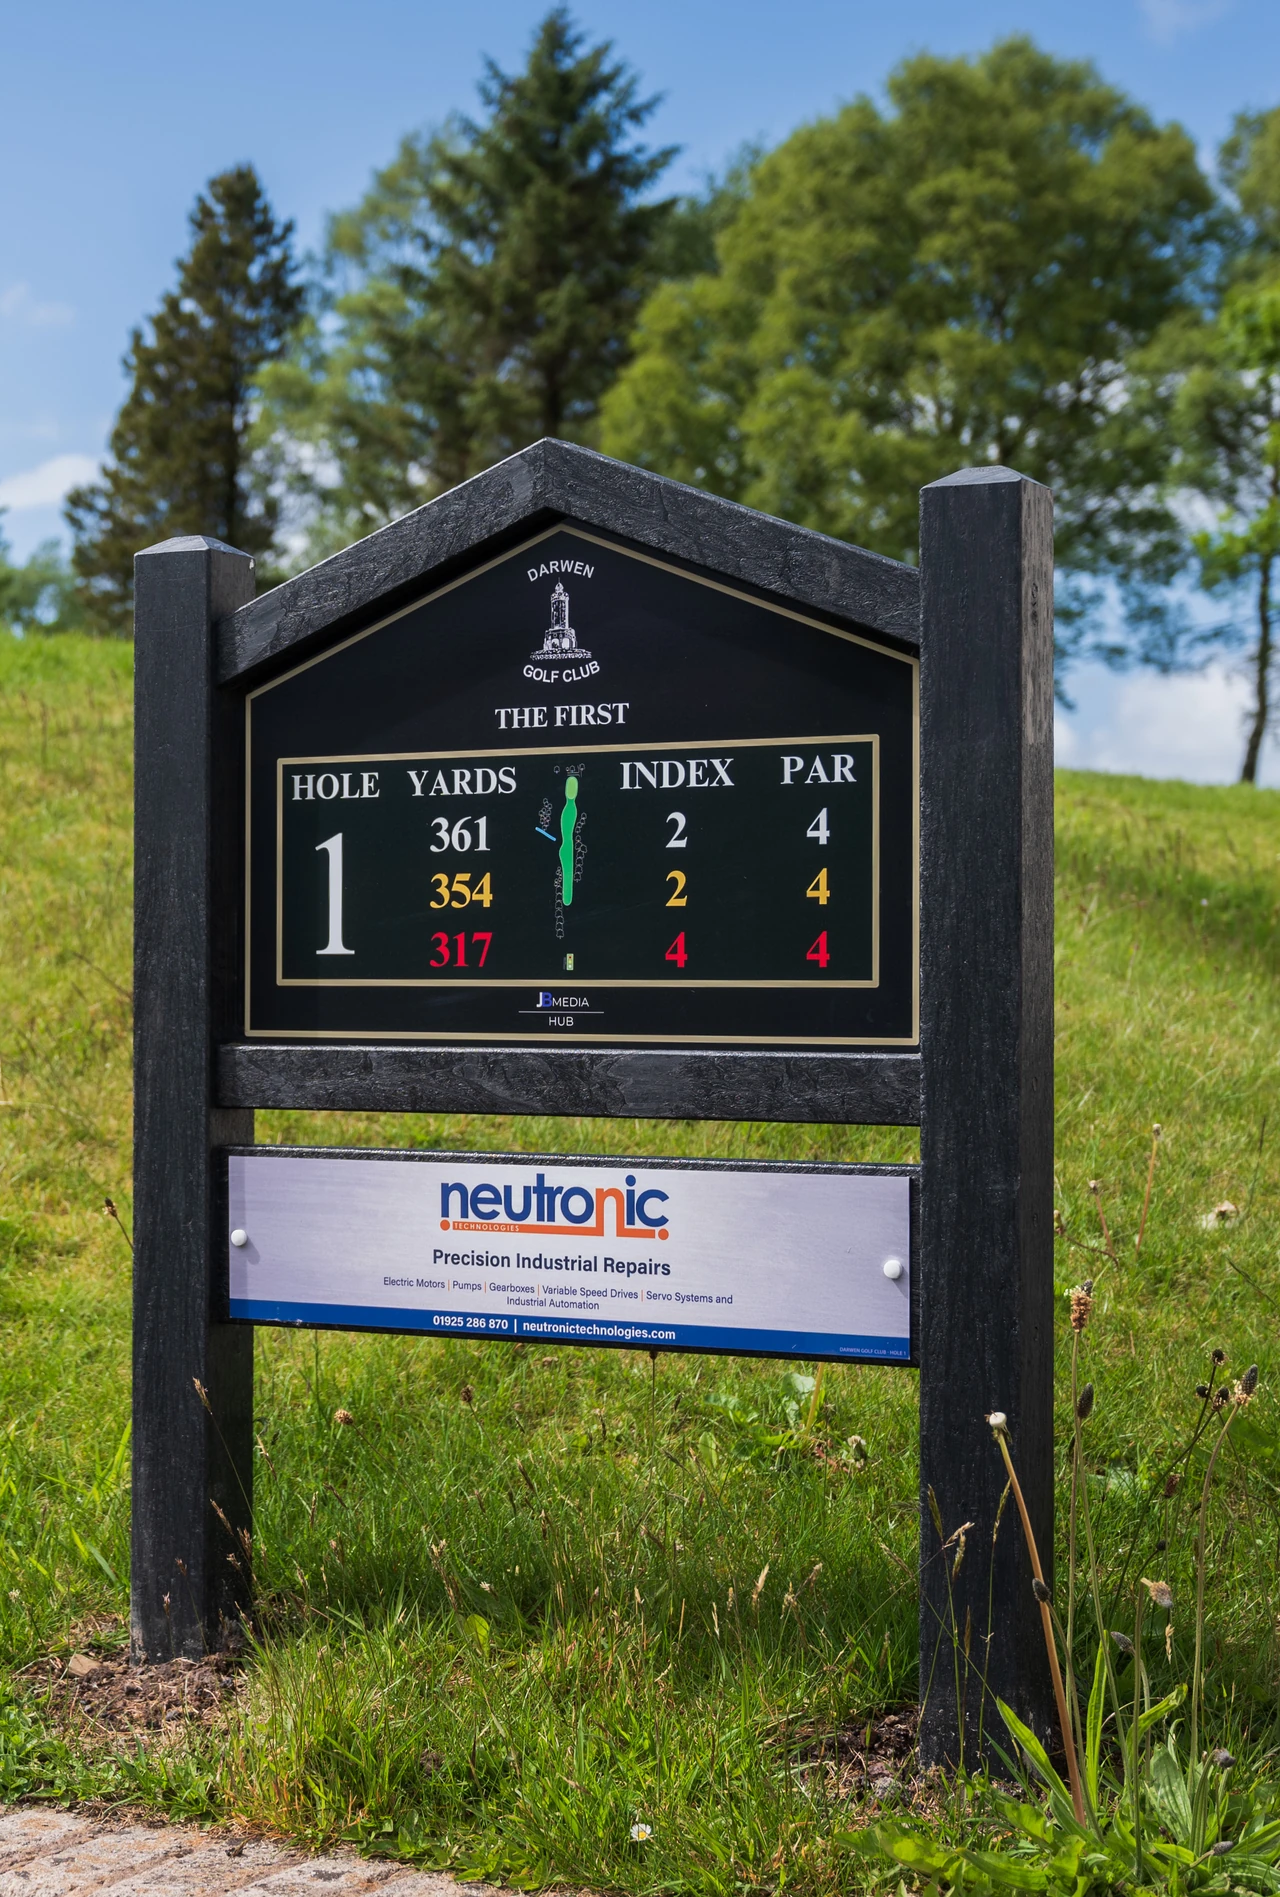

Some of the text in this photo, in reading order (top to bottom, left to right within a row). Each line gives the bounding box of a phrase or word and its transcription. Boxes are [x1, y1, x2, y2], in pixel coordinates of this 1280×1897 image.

[527, 559, 595, 582] DARWEN
[523, 661, 600, 683] GOLF CLUB
[495, 703, 629, 729] THE FIRST
[292, 755, 856, 800] HOLE YARDS INDEX PAR
[430, 808, 830, 852] 361 2 4
[316, 833, 355, 954] 1
[430, 868, 830, 908] 354 2 4
[430, 931, 830, 967] 317 4 4
[548, 1016, 574, 1027] HUB
[440, 1173, 670, 1229] neutronic
[454, 1222, 520, 1232] TECHNOLOGIES
[433, 1248, 671, 1278] Precision Industrial Repairs
[383, 1276, 732, 1304] Electric Motors Pumps Gearboxes Variable Speed Drives Servo Systems and
[507, 1297, 600, 1309] Industrial Automation
[432, 1315, 676, 1340] 01925 286 870 neutronictechnologies.com
